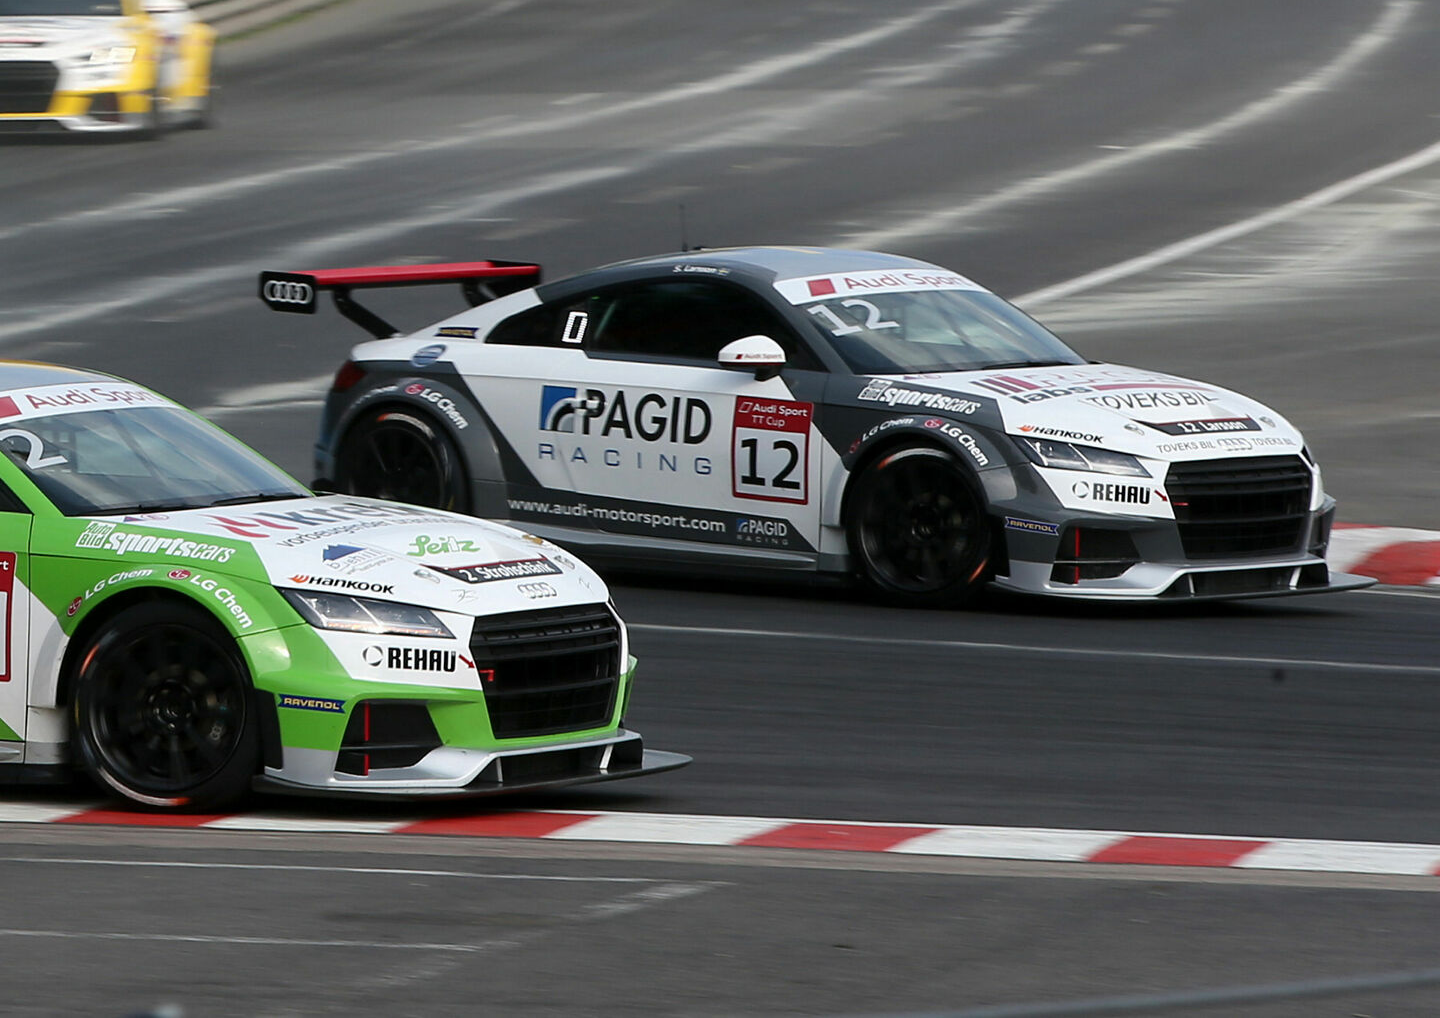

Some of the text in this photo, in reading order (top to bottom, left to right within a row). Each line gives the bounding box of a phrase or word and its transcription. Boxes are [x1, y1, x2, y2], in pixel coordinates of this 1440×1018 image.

[844, 273, 904, 290] Audi
[807, 298, 900, 337] 12
[24, 388, 97, 410] Audi
[879, 388, 981, 415] sportscars
[1009, 385, 1093, 404] labs
[1086, 391, 1182, 410] TOVEKS
[420, 388, 444, 403] LG
[437, 398, 469, 430] Chem
[583, 388, 713, 445] PAGID
[752, 403, 808, 417] Audi Sport
[752, 415, 786, 428] TT Cup
[1177, 420, 1248, 433] 12 Larsson
[862, 425, 879, 442] LG
[940, 423, 989, 466] LG Chem
[538, 443, 712, 475] RACING
[741, 438, 800, 490] 12
[1093, 483, 1150, 505] REHAU
[509, 499, 726, 533] www.audi-motorsport.com
[749, 519, 788, 537] PAGID
[104, 532, 237, 563] sportscars
[85, 569, 153, 600] LG Chem
[460, 569, 478, 582] 2
[190, 575, 253, 628] LG Chem
[388, 648, 457, 672] REHAU
[284, 697, 340, 711] RAVENOL
